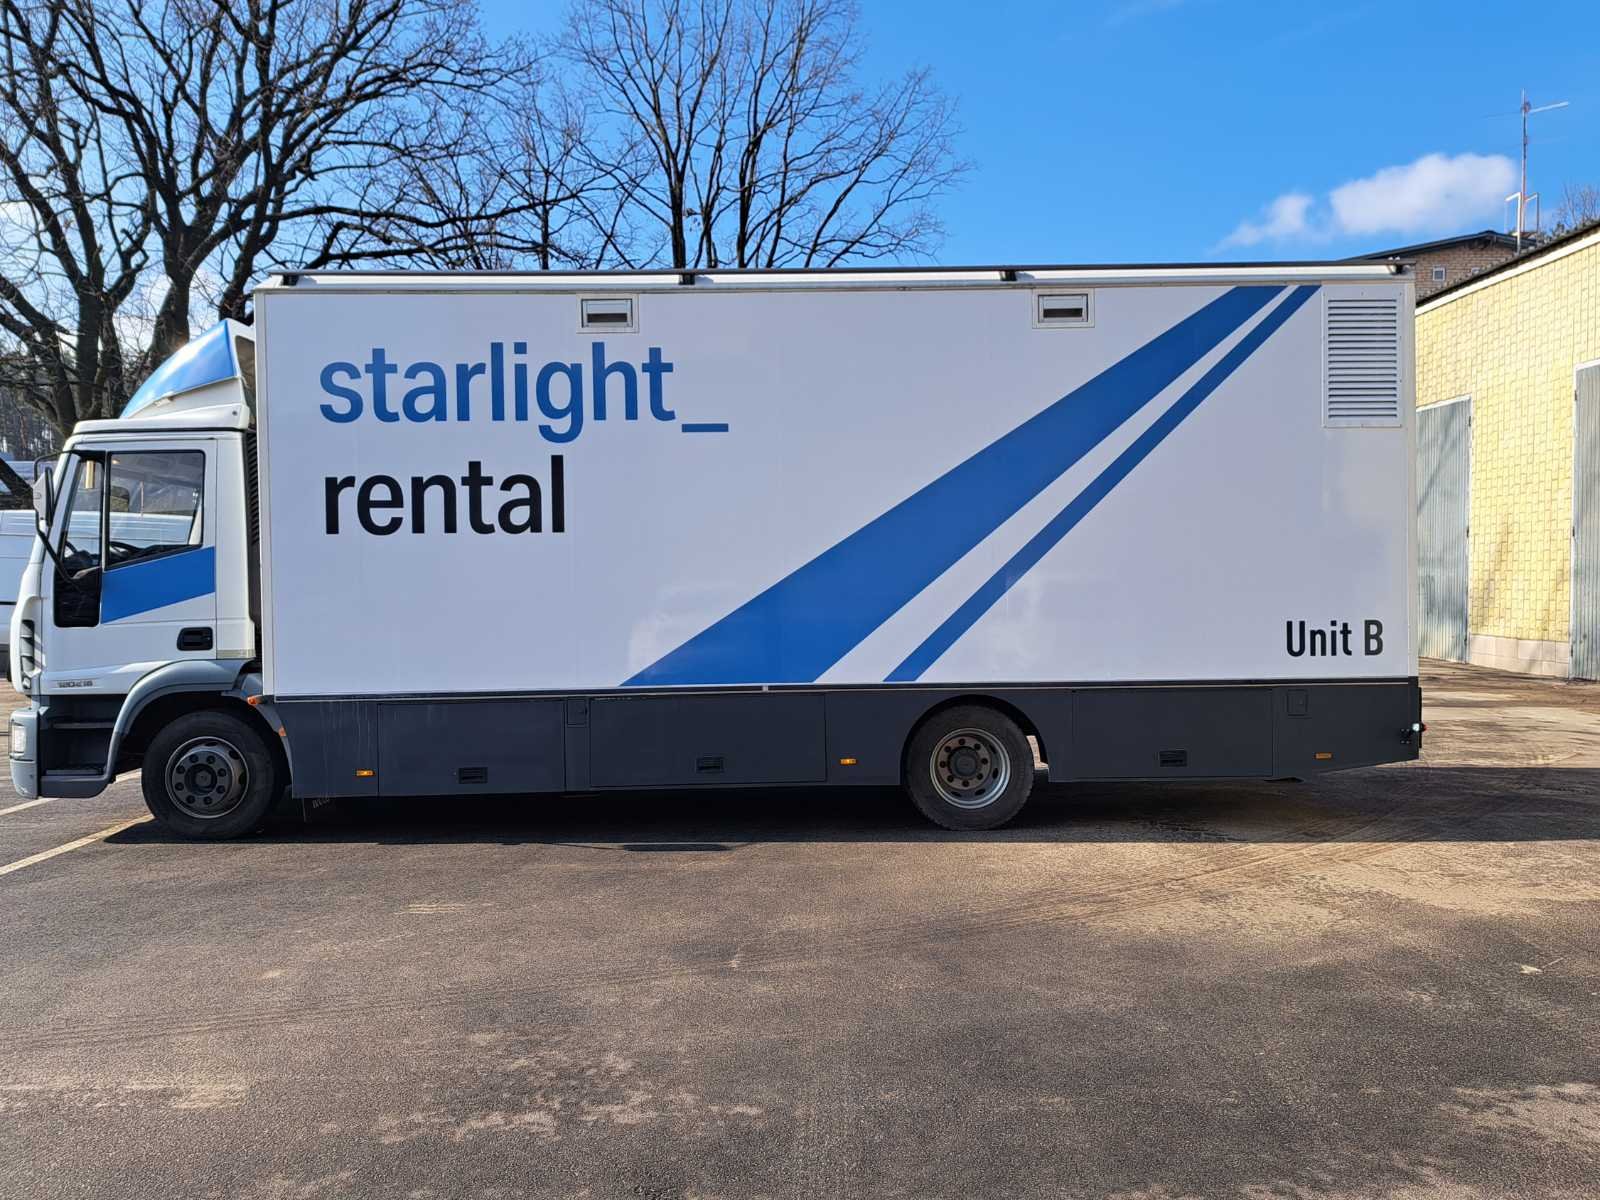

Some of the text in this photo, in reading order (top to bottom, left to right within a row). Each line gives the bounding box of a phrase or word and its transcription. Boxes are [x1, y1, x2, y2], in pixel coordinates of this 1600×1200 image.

[324, 454, 566, 536] rental
[1286, 619, 1384, 658] Unit B
